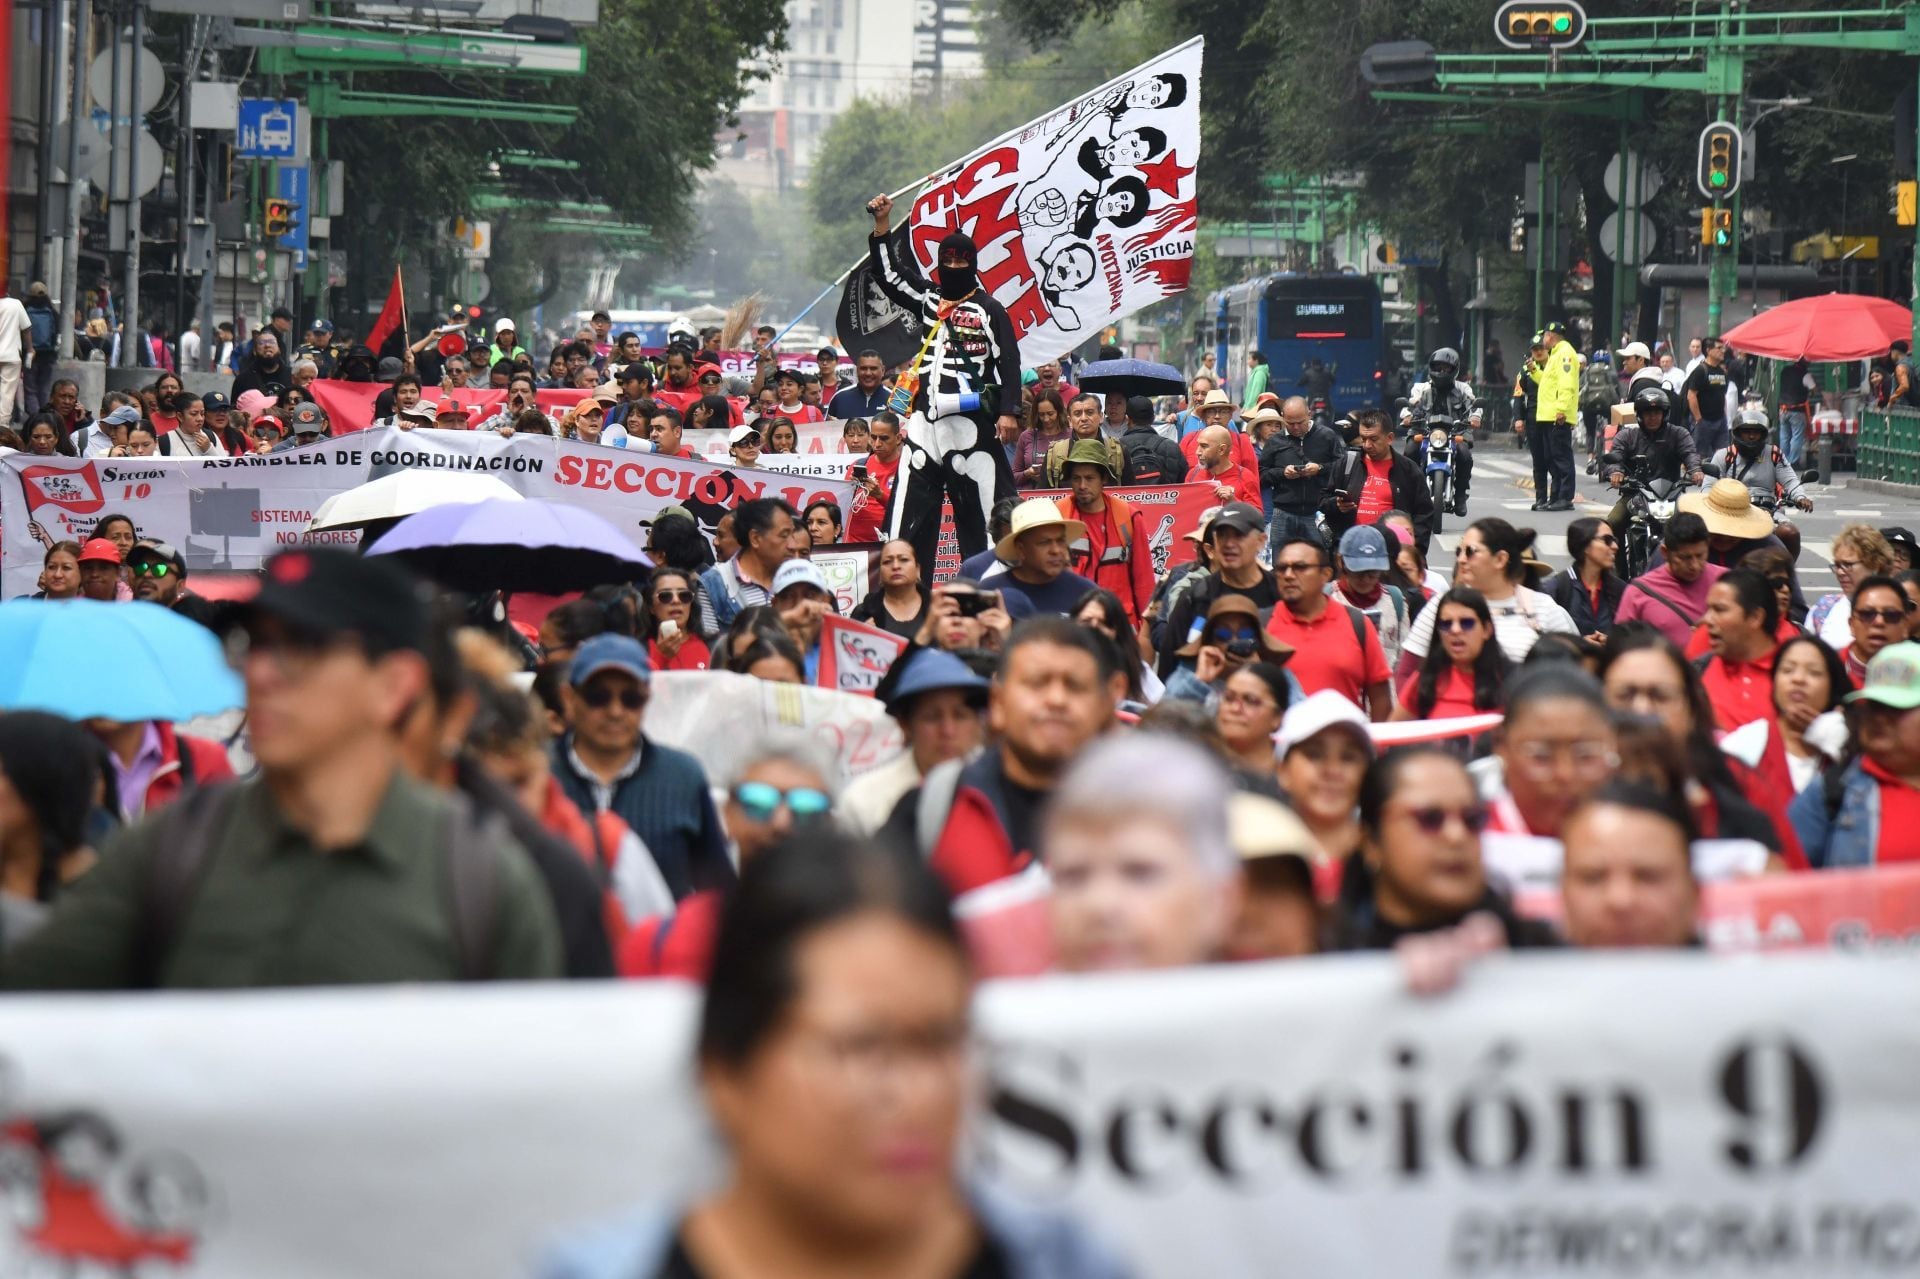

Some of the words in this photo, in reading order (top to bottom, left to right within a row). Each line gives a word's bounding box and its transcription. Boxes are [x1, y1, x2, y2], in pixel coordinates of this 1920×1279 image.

[954, 146, 1051, 340] CNTE
[1126, 240, 1193, 273] JUSTICIA
[203, 452, 327, 469] ASAMBLEA
[336, 450, 362, 465] DE
[370, 450, 543, 473] COORDINACIÓN
[123, 483, 152, 501] 10
[554, 454, 767, 508] SECCIÓN
[1164, 490, 1179, 499] 10
[251, 510, 312, 523] SISTEMA
[276, 531, 298, 544] NO
[302, 531, 358, 544] AFORES
[984, 1037, 1657, 1188] Sección
[1713, 1033, 1831, 1182] 9
